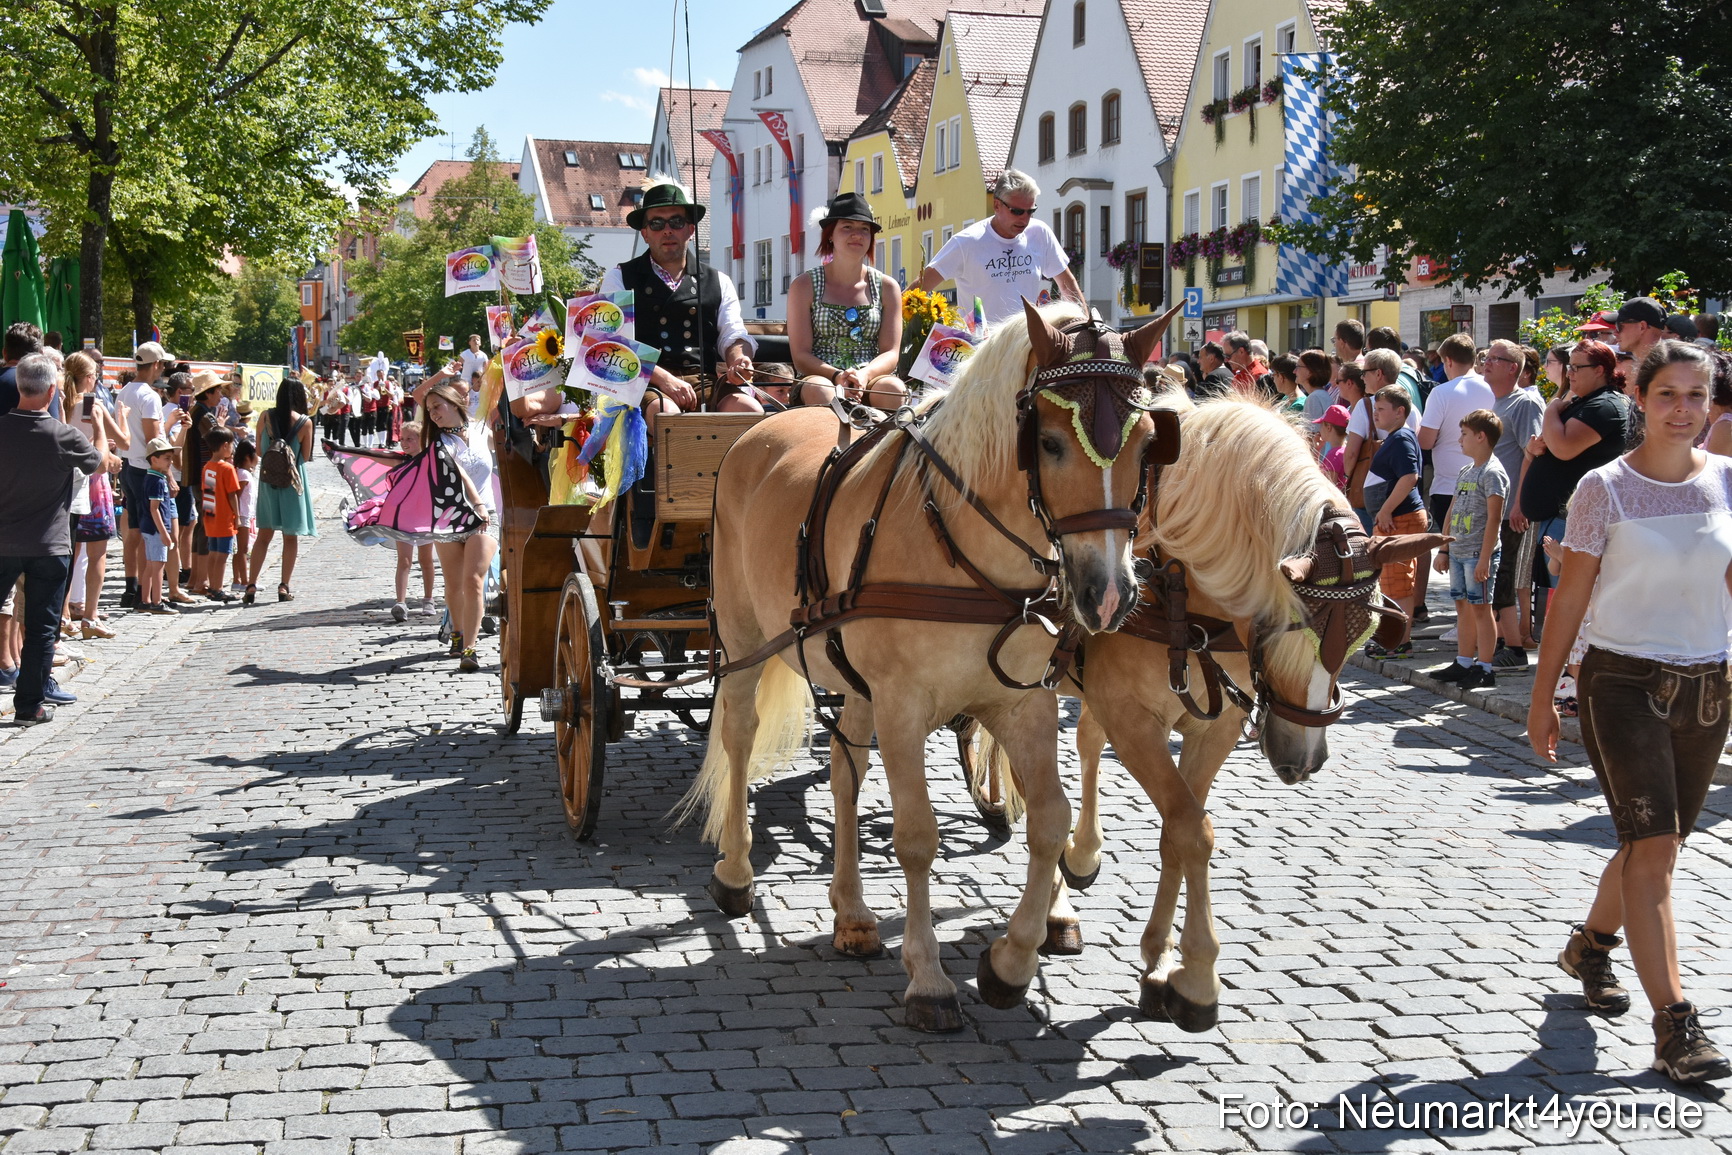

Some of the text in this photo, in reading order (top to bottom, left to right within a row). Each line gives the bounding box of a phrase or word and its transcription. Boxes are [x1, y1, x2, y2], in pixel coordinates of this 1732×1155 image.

[888, 213, 911, 230] Lehmeier
[453, 256, 489, 274] ARTICO
[985, 249, 1033, 270] ARTICO
[1011, 269, 1032, 278] sports
[1187, 291, 1199, 315] P
[574, 306, 621, 327] ARTICO
[585, 346, 639, 373] ARTICO
[609, 369, 631, 380] sports
[524, 380, 552, 392] www.artico.de
[587, 381, 618, 394] www.artico.de
